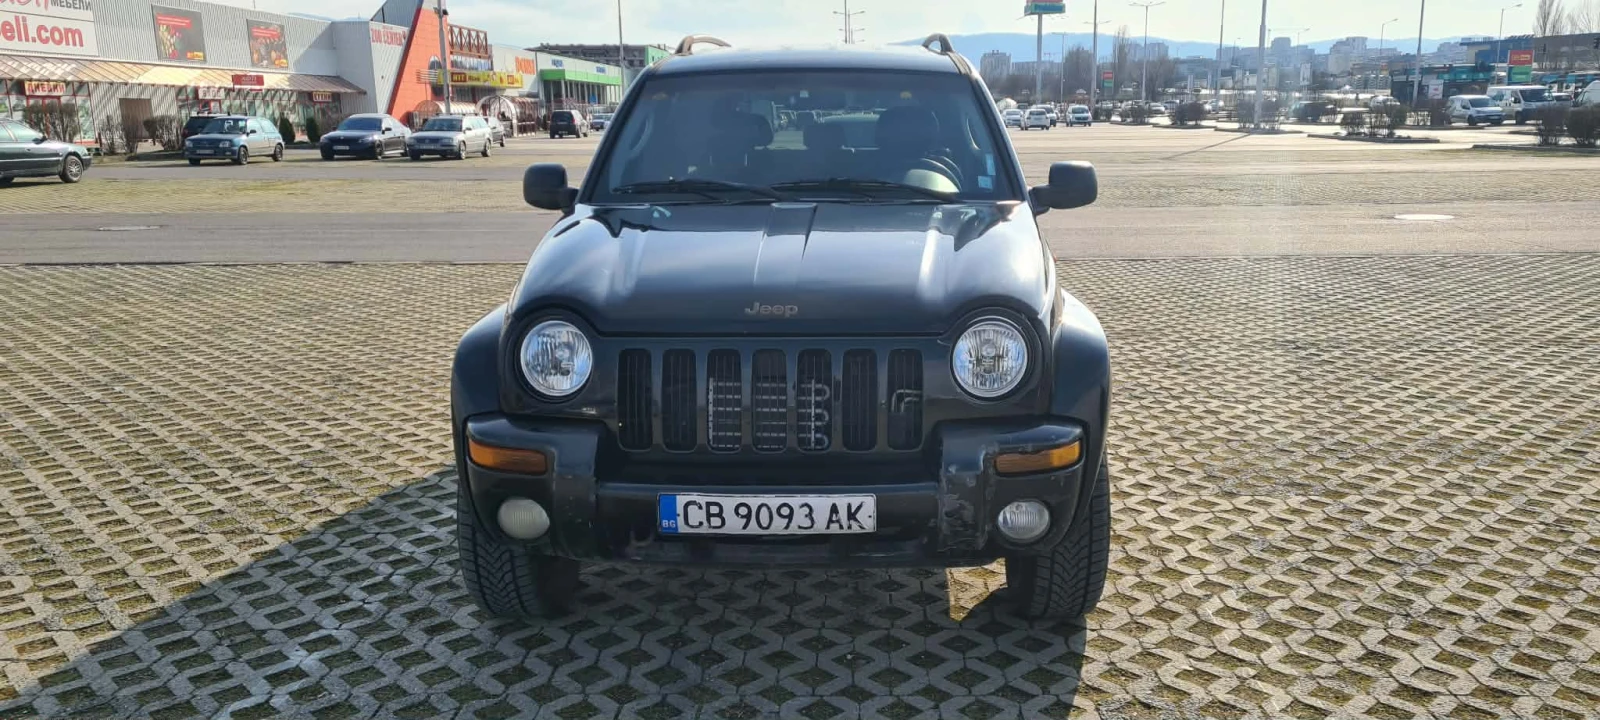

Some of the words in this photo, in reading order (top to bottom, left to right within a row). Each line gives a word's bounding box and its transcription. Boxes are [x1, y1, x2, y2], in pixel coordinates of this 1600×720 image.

[0, 15, 84, 47] eli.com
[744, 302, 799, 318] Jeep
[662, 520, 676, 528] BG
[733, 502, 816, 530] 9093
